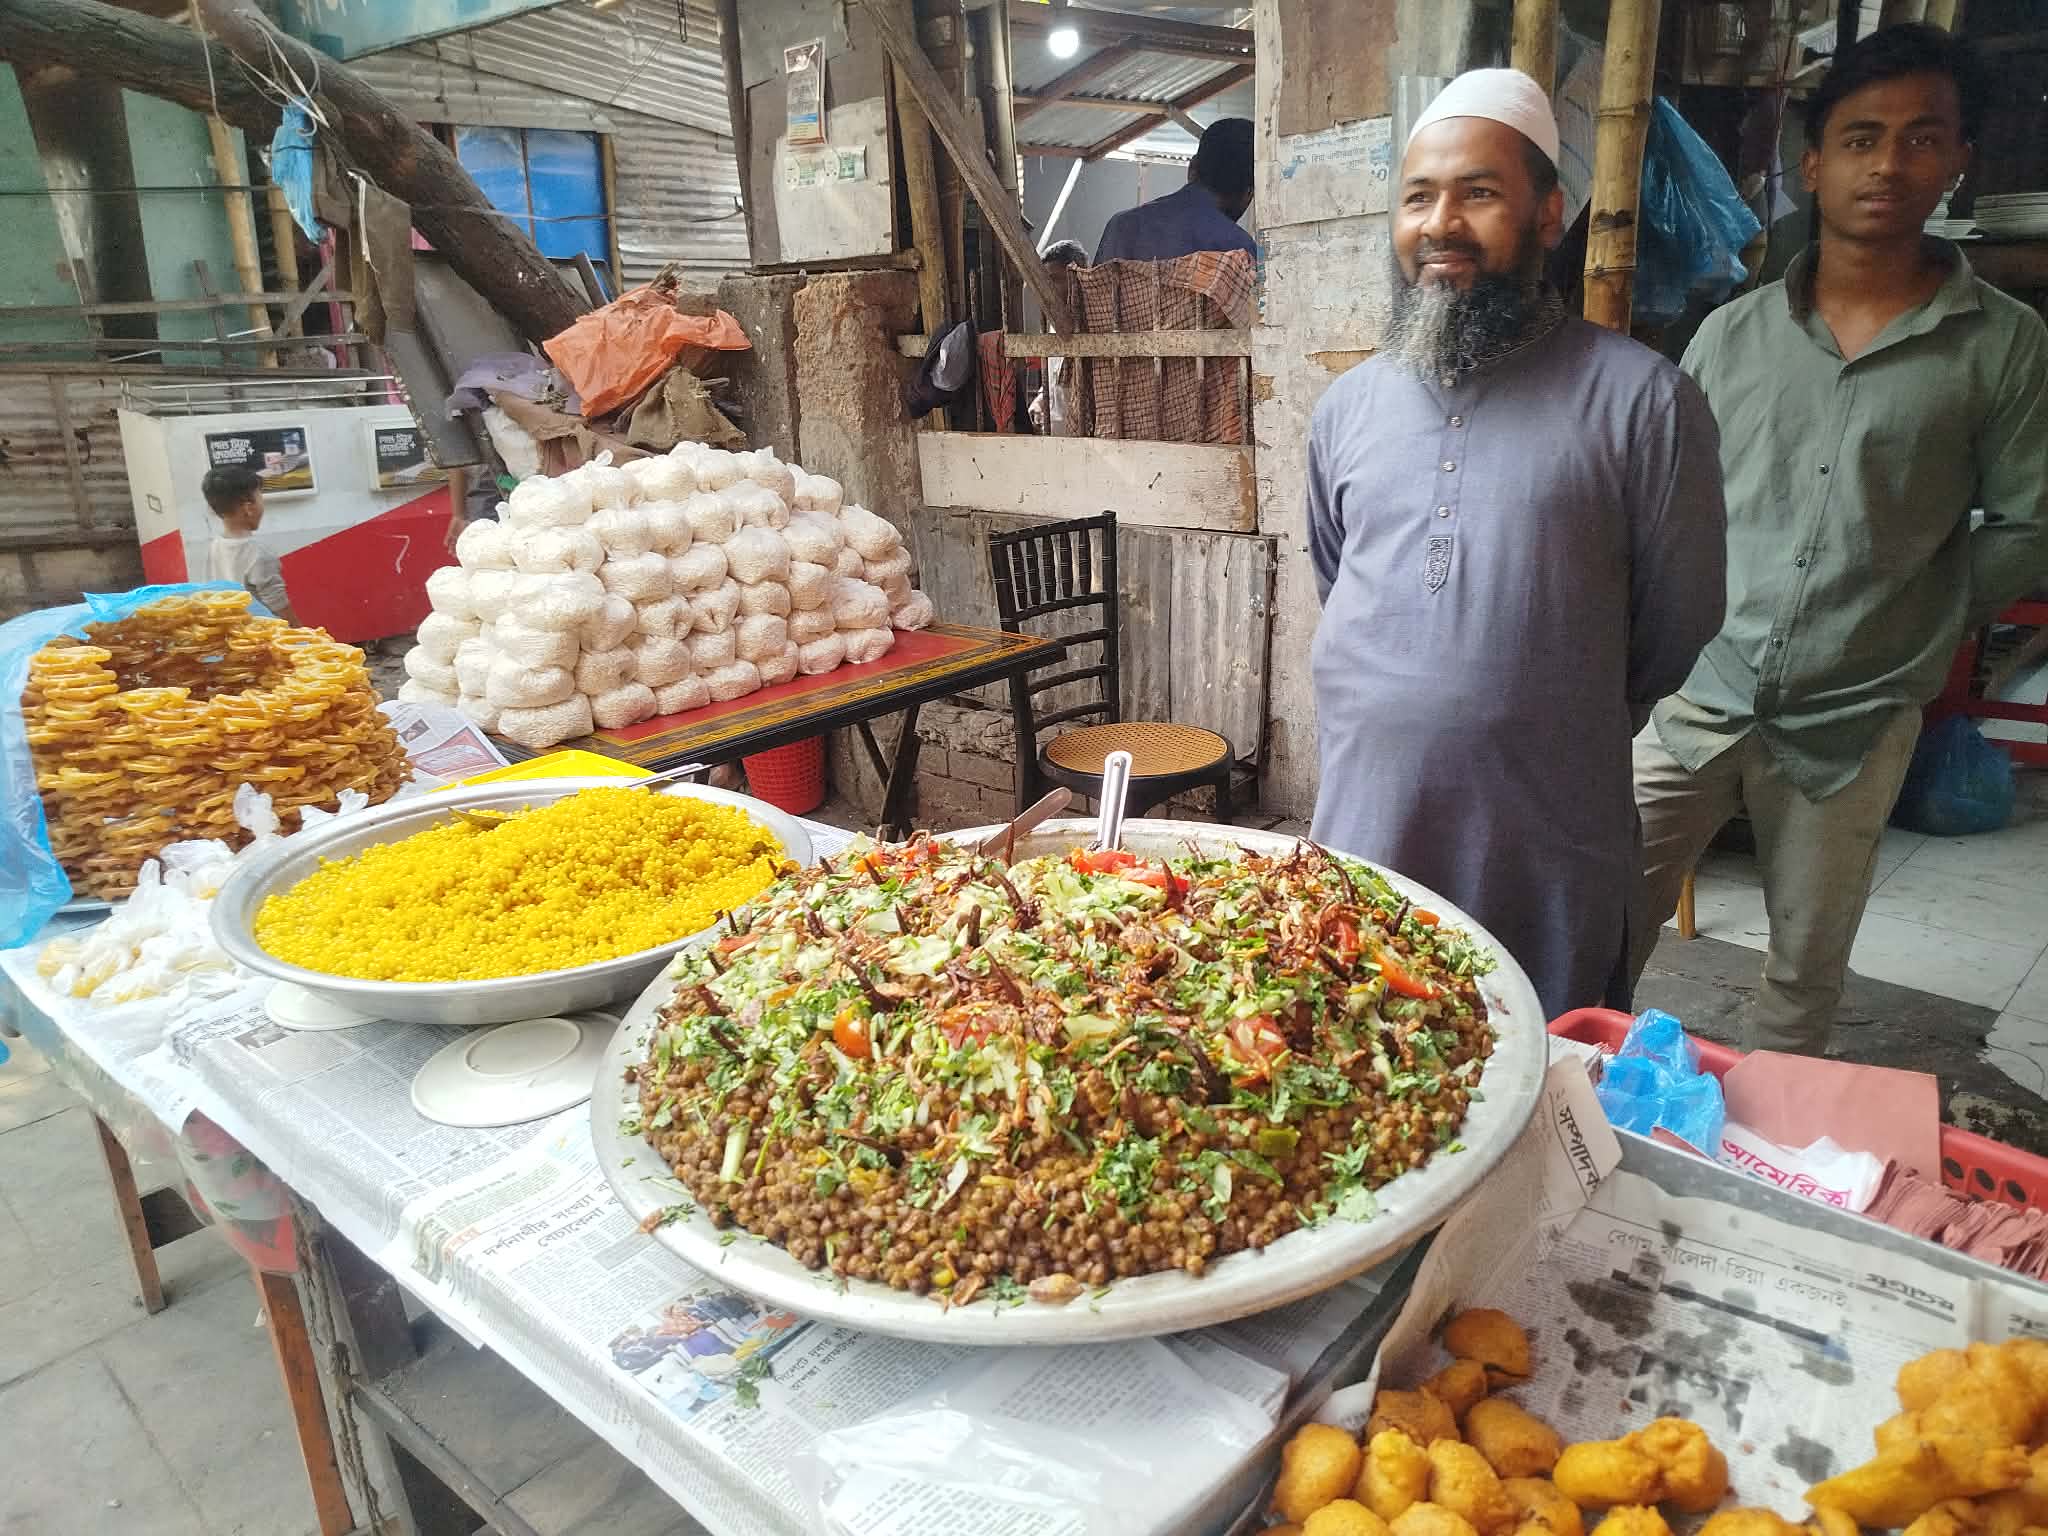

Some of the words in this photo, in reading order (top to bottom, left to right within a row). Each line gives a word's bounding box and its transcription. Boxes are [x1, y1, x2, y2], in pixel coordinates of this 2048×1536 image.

[1721, 1138, 1853, 1210] আমেরিকা
[1607, 1228, 1653, 1249] বেগম
[1727, 1256, 1765, 1285] জিয়া
